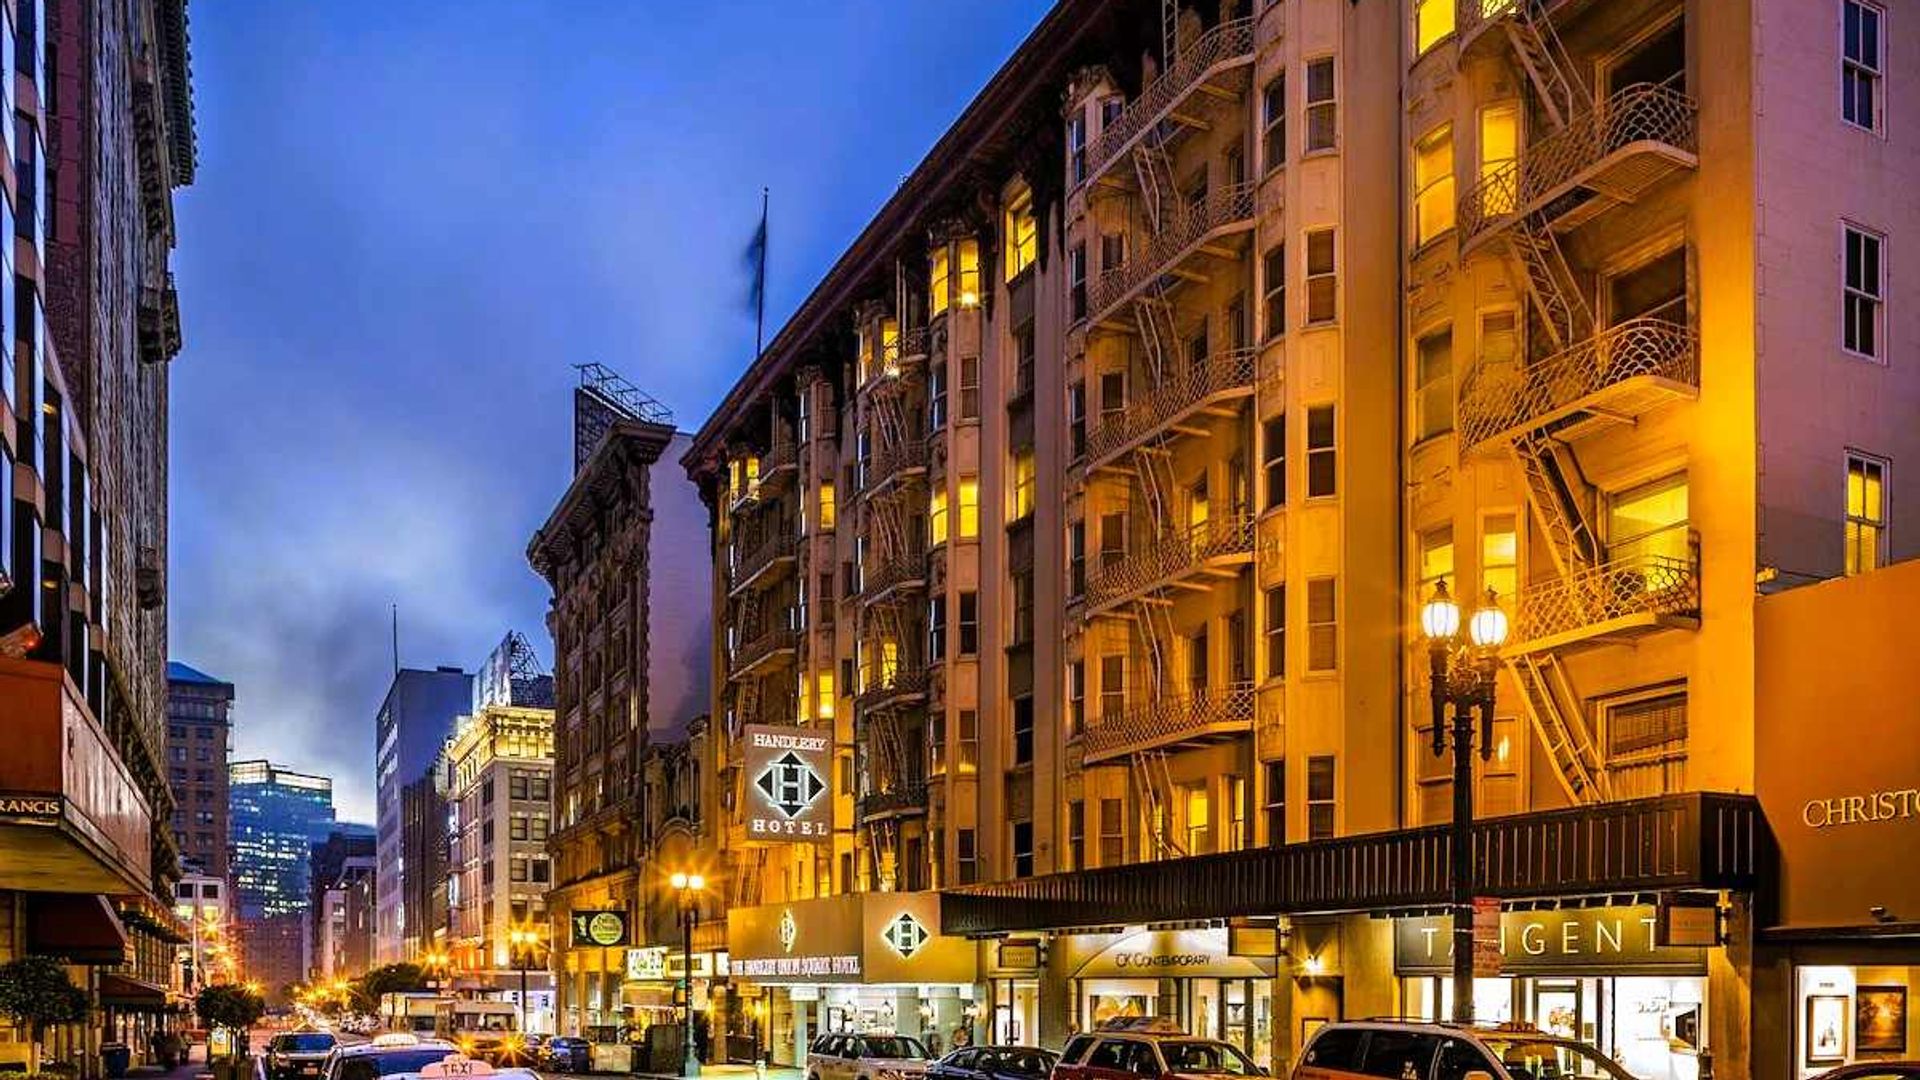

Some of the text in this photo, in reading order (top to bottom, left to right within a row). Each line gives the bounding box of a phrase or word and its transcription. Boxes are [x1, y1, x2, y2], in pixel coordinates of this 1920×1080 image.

[753, 733, 827, 751] HANDLERY
[1803, 789, 1920, 827] CHRIST
[753, 819, 828, 836] HOTEL
[832, 955, 860, 975] HOTEL
[441, 1063, 472, 1077] TAXI
